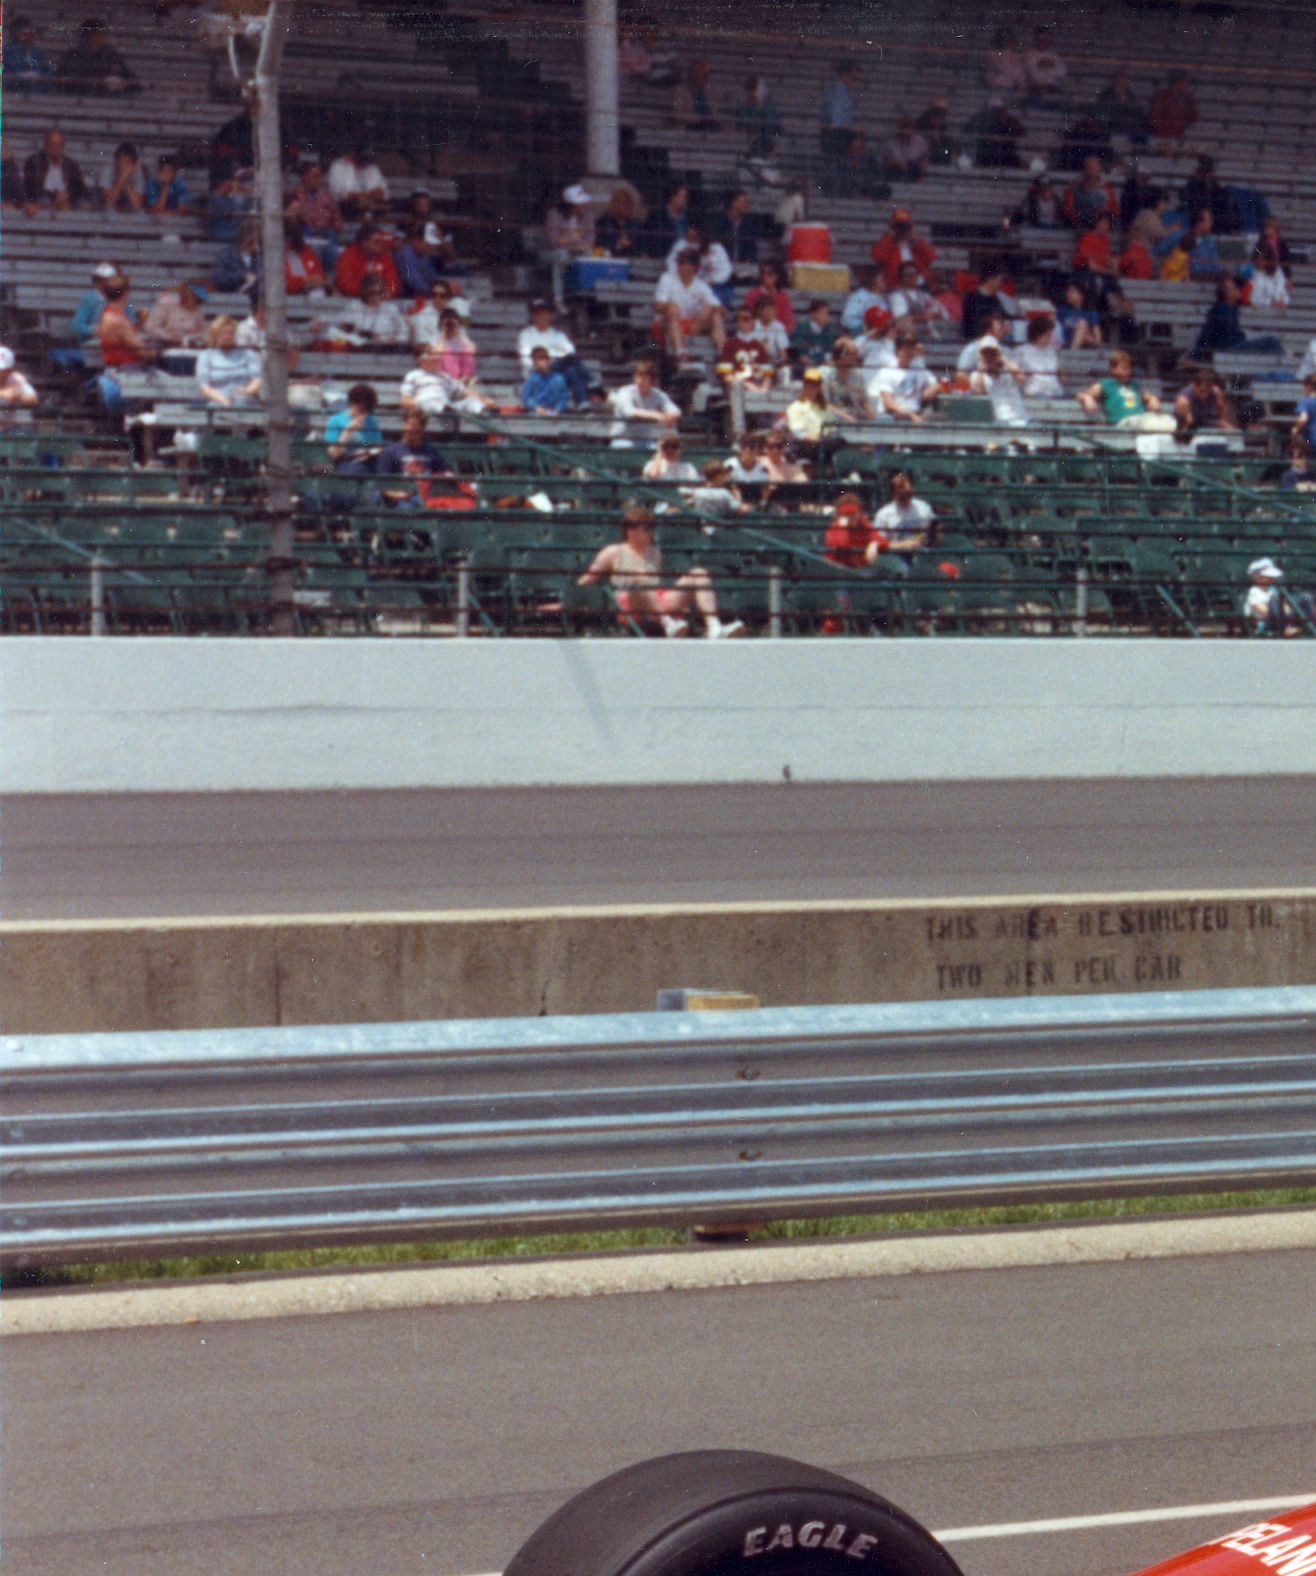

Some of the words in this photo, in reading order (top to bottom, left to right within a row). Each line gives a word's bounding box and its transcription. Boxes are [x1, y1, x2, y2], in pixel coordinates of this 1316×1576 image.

[925, 915, 978, 942] THIS
[1077, 904, 1229, 938] RESTRICTED
[936, 964, 982, 990] TWO
[1074, 956, 1117, 985] PER
[1134, 953, 1181, 984] CAR
[742, 1520, 880, 1559] EAGLE
